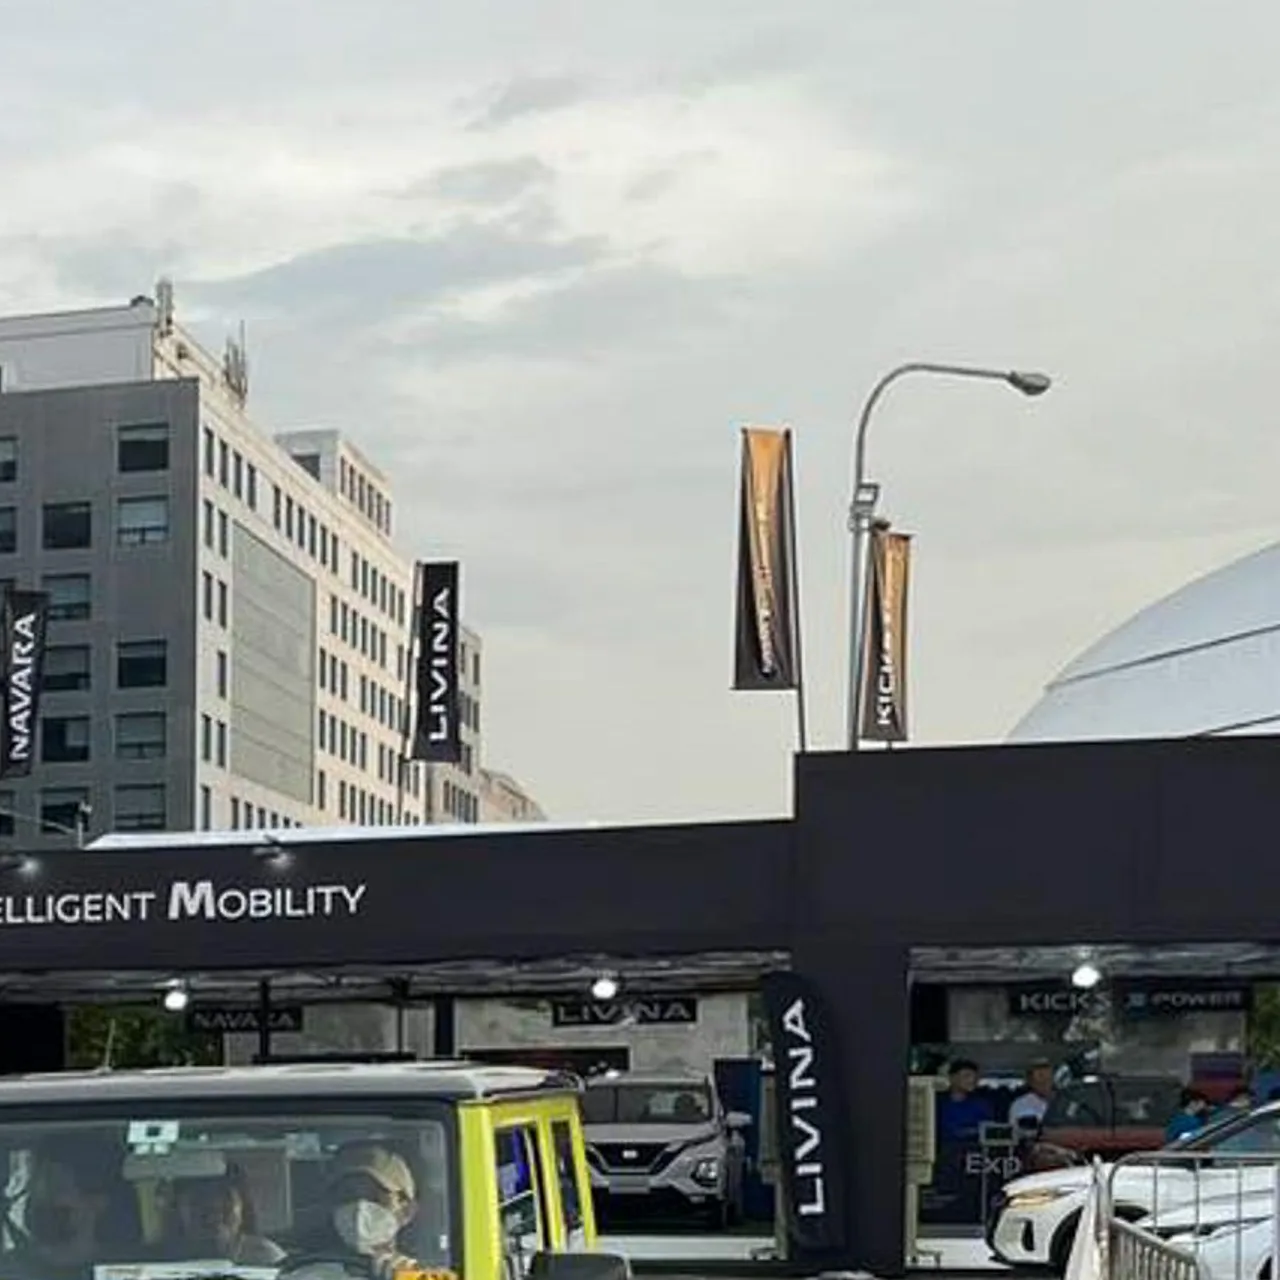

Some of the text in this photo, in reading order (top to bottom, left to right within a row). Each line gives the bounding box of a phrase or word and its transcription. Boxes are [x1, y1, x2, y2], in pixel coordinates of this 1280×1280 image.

[9, 613, 36, 760] NAVARA
[429, 586, 450, 742] LIVINA
[168, 881, 366, 921] MOBILITY
[558, 1002, 691, 1023] LIVINA
[783, 998, 824, 1216] LIVINA
